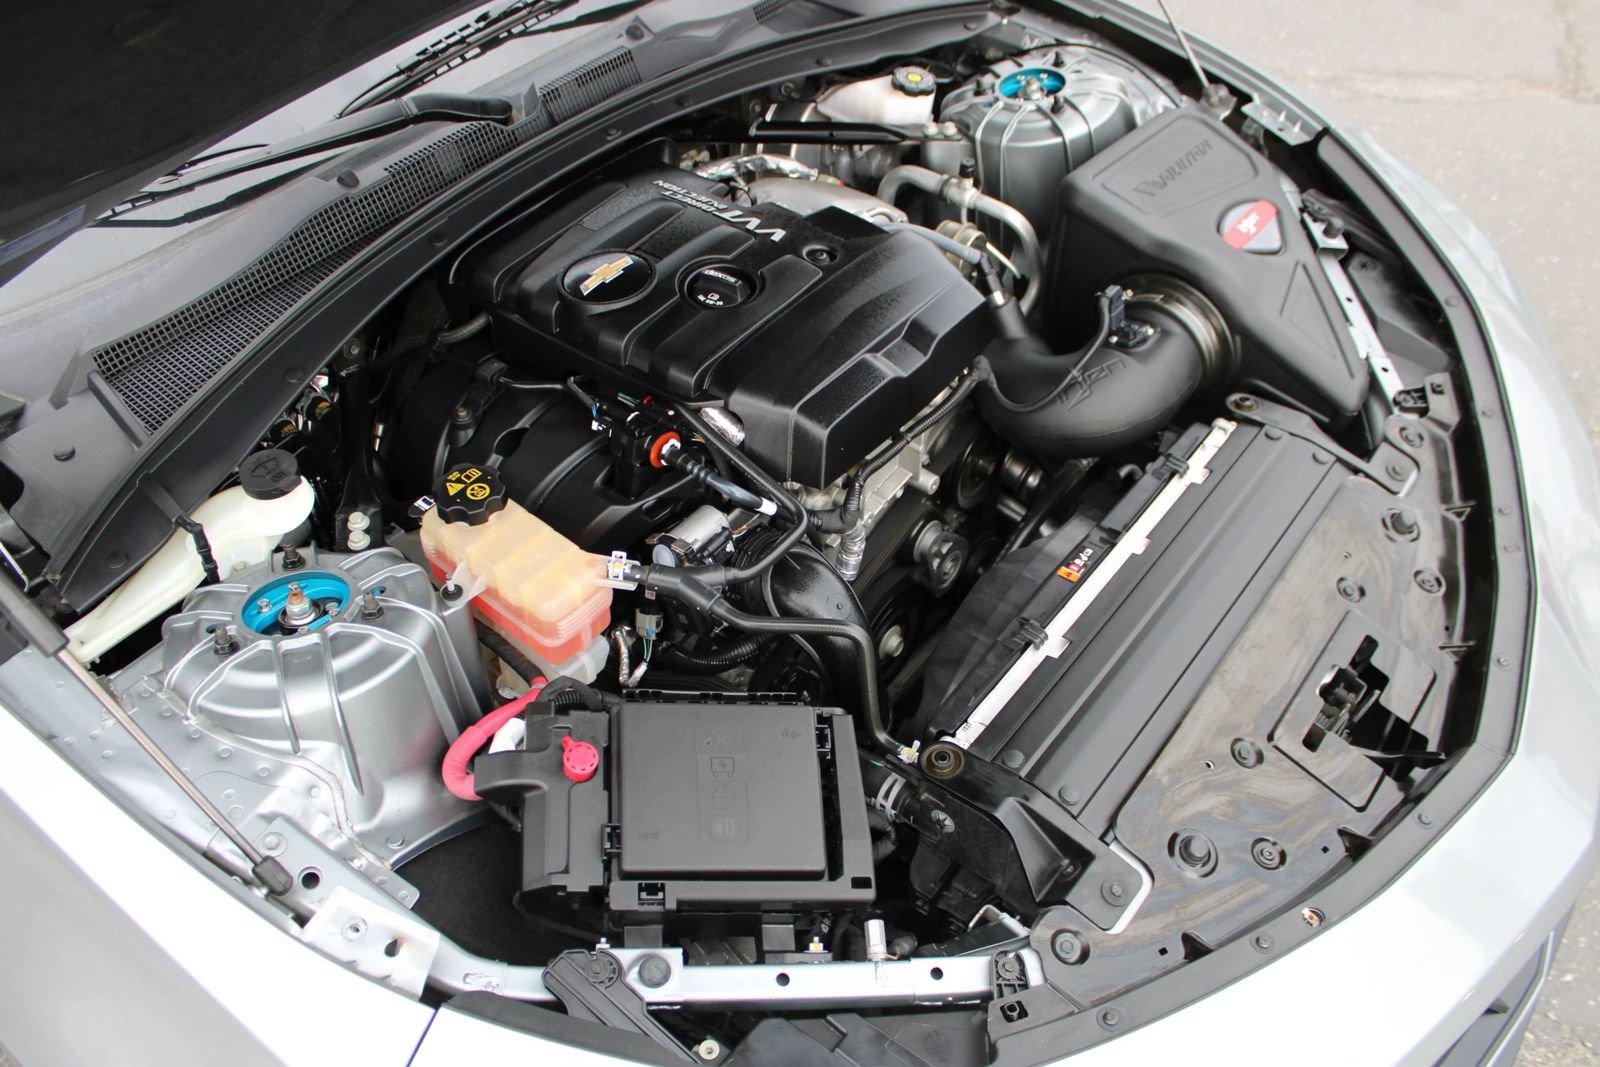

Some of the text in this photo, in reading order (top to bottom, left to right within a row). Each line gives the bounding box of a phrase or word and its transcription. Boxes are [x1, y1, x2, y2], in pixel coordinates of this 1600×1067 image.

[653, 180, 728, 210] INJECTION
[661, 191, 785, 242] VVT DIRECT
